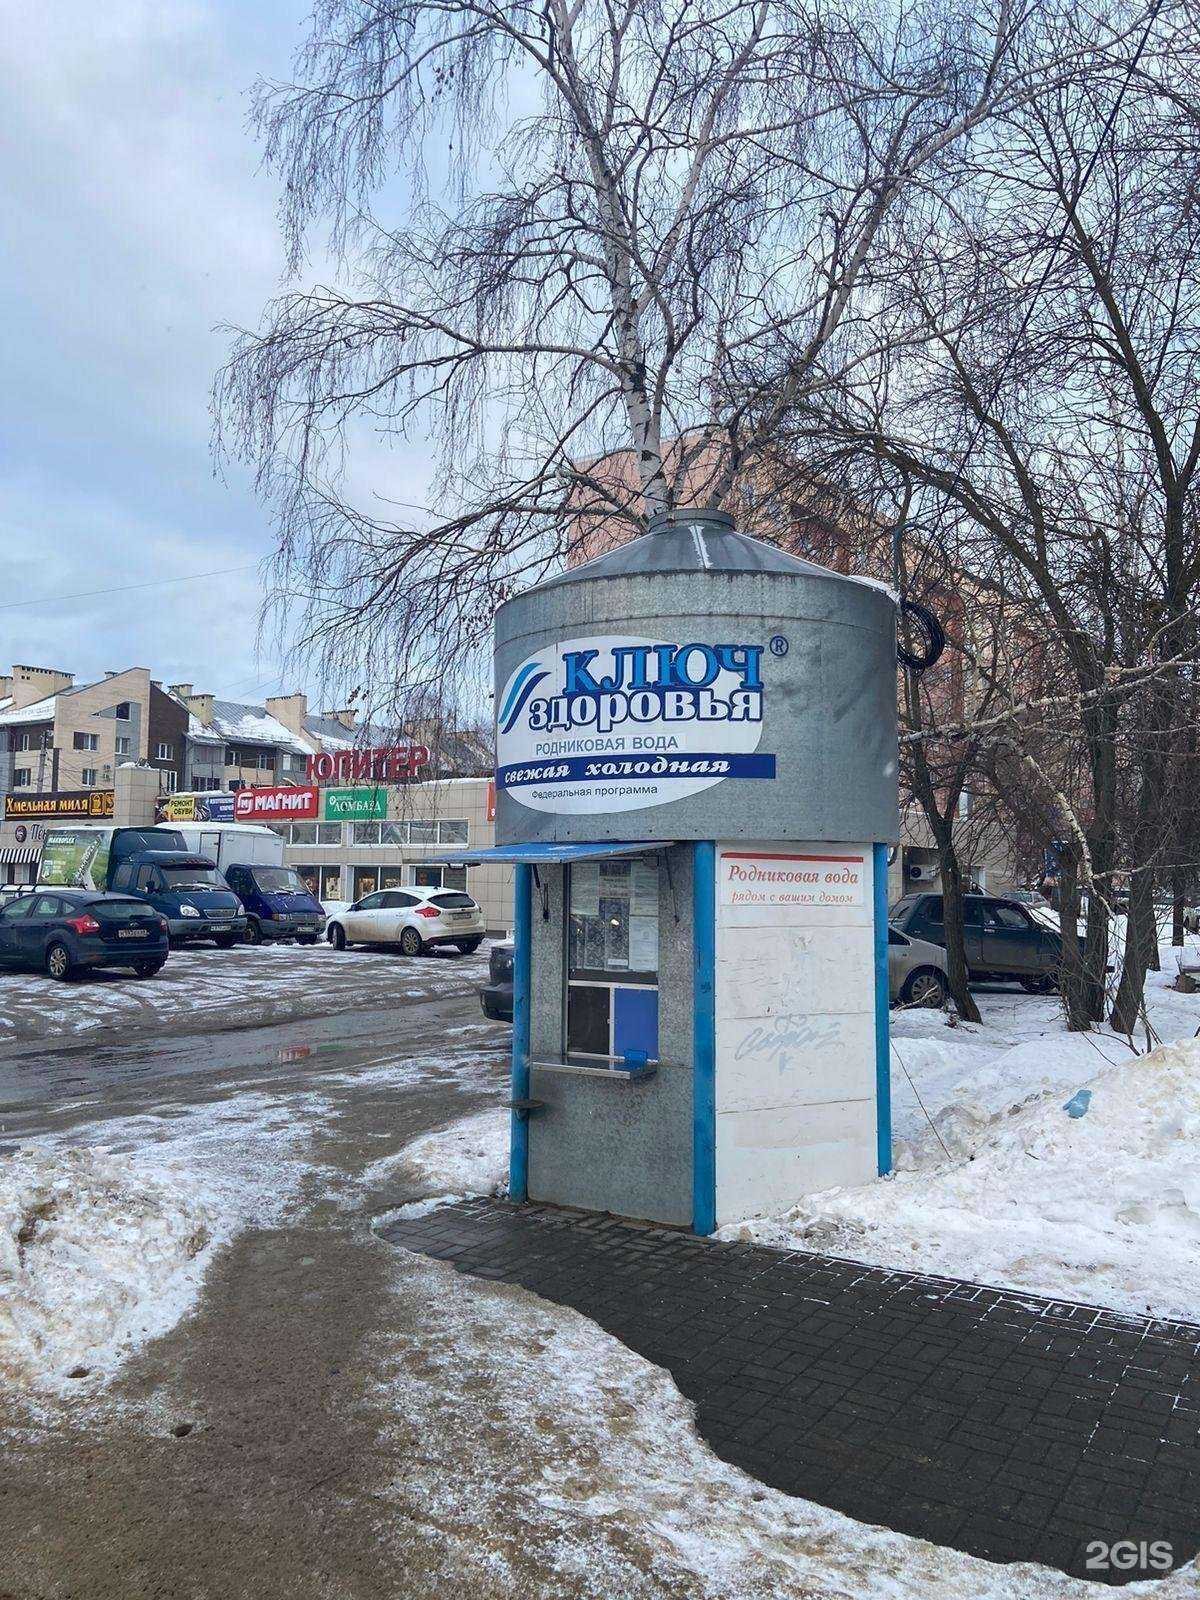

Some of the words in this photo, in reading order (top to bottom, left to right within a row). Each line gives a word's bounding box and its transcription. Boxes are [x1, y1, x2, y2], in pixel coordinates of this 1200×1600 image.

[563, 642, 764, 694] КЛЮЧ
[535, 737, 626, 755] РОДНИКОВАЯ
[632, 736, 679, 751] ВОДА
[306, 746, 430, 781] ЮПИТЕР
[504, 763, 570, 783] свежая
[585, 755, 731, 776] холодная
[254, 791, 313, 811] МАГНИТ
[531, 787, 592, 799] Федеральная
[594, 784, 658, 798] программа
[6, 797, 57, 813] Хмельная
[60, 798, 88, 812] миля
[728, 865, 820, 883] Родниковая
[825, 867, 859, 884] вода
[731, 890, 766, 904] рядом
[769, 894, 776, 902] с
[778, 894, 817, 903] вашим
[819, 891, 853, 903] домом
